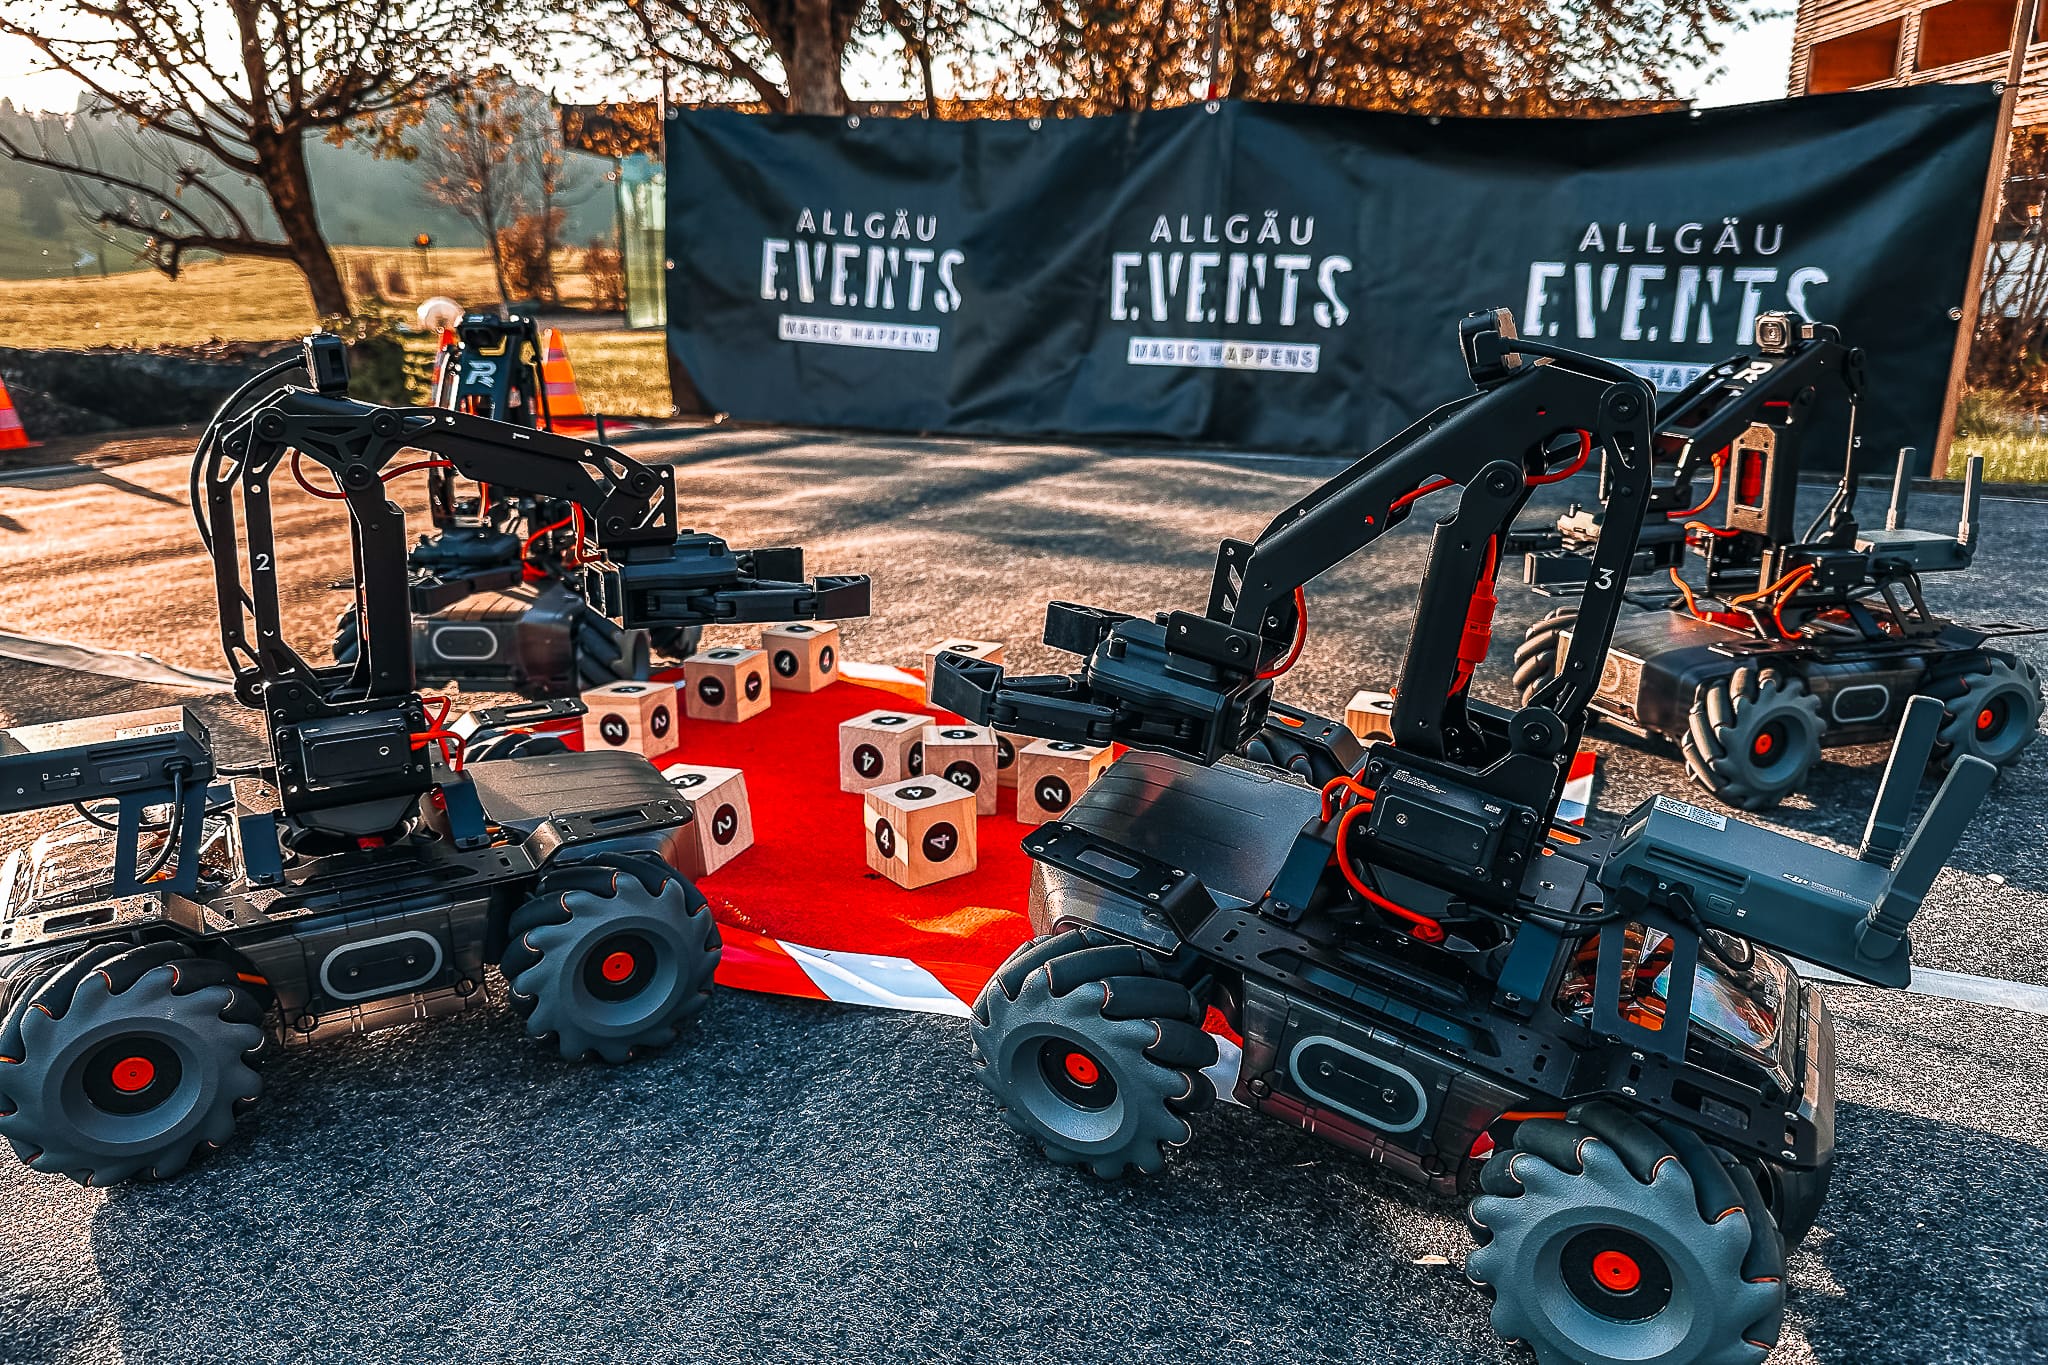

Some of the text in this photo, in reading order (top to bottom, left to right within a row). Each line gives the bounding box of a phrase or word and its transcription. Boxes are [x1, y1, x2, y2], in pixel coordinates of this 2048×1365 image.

[796, 207, 937, 242] ALLGÄU
[1149, 209, 1316, 246] ALLGÄU
[1577, 217, 1785, 256] ALLGÄU
[760, 237, 966, 314] EVENTS
[1110, 251, 1353, 329] EVENTS
[255, 553, 271, 571] 2
[1594, 567, 1615, 590] 3
[780, 655, 791, 671] 4
[605, 722, 623, 737] 2
[655, 715, 667, 730] 2
[862, 752, 876, 771] 4
[951, 771, 972, 787] 3
[906, 788, 923, 798] 4
[1043, 787, 1063, 803] 2
[717, 815, 732, 835] 2
[880, 828, 890, 850] 4
[930, 834, 950, 850] 4
